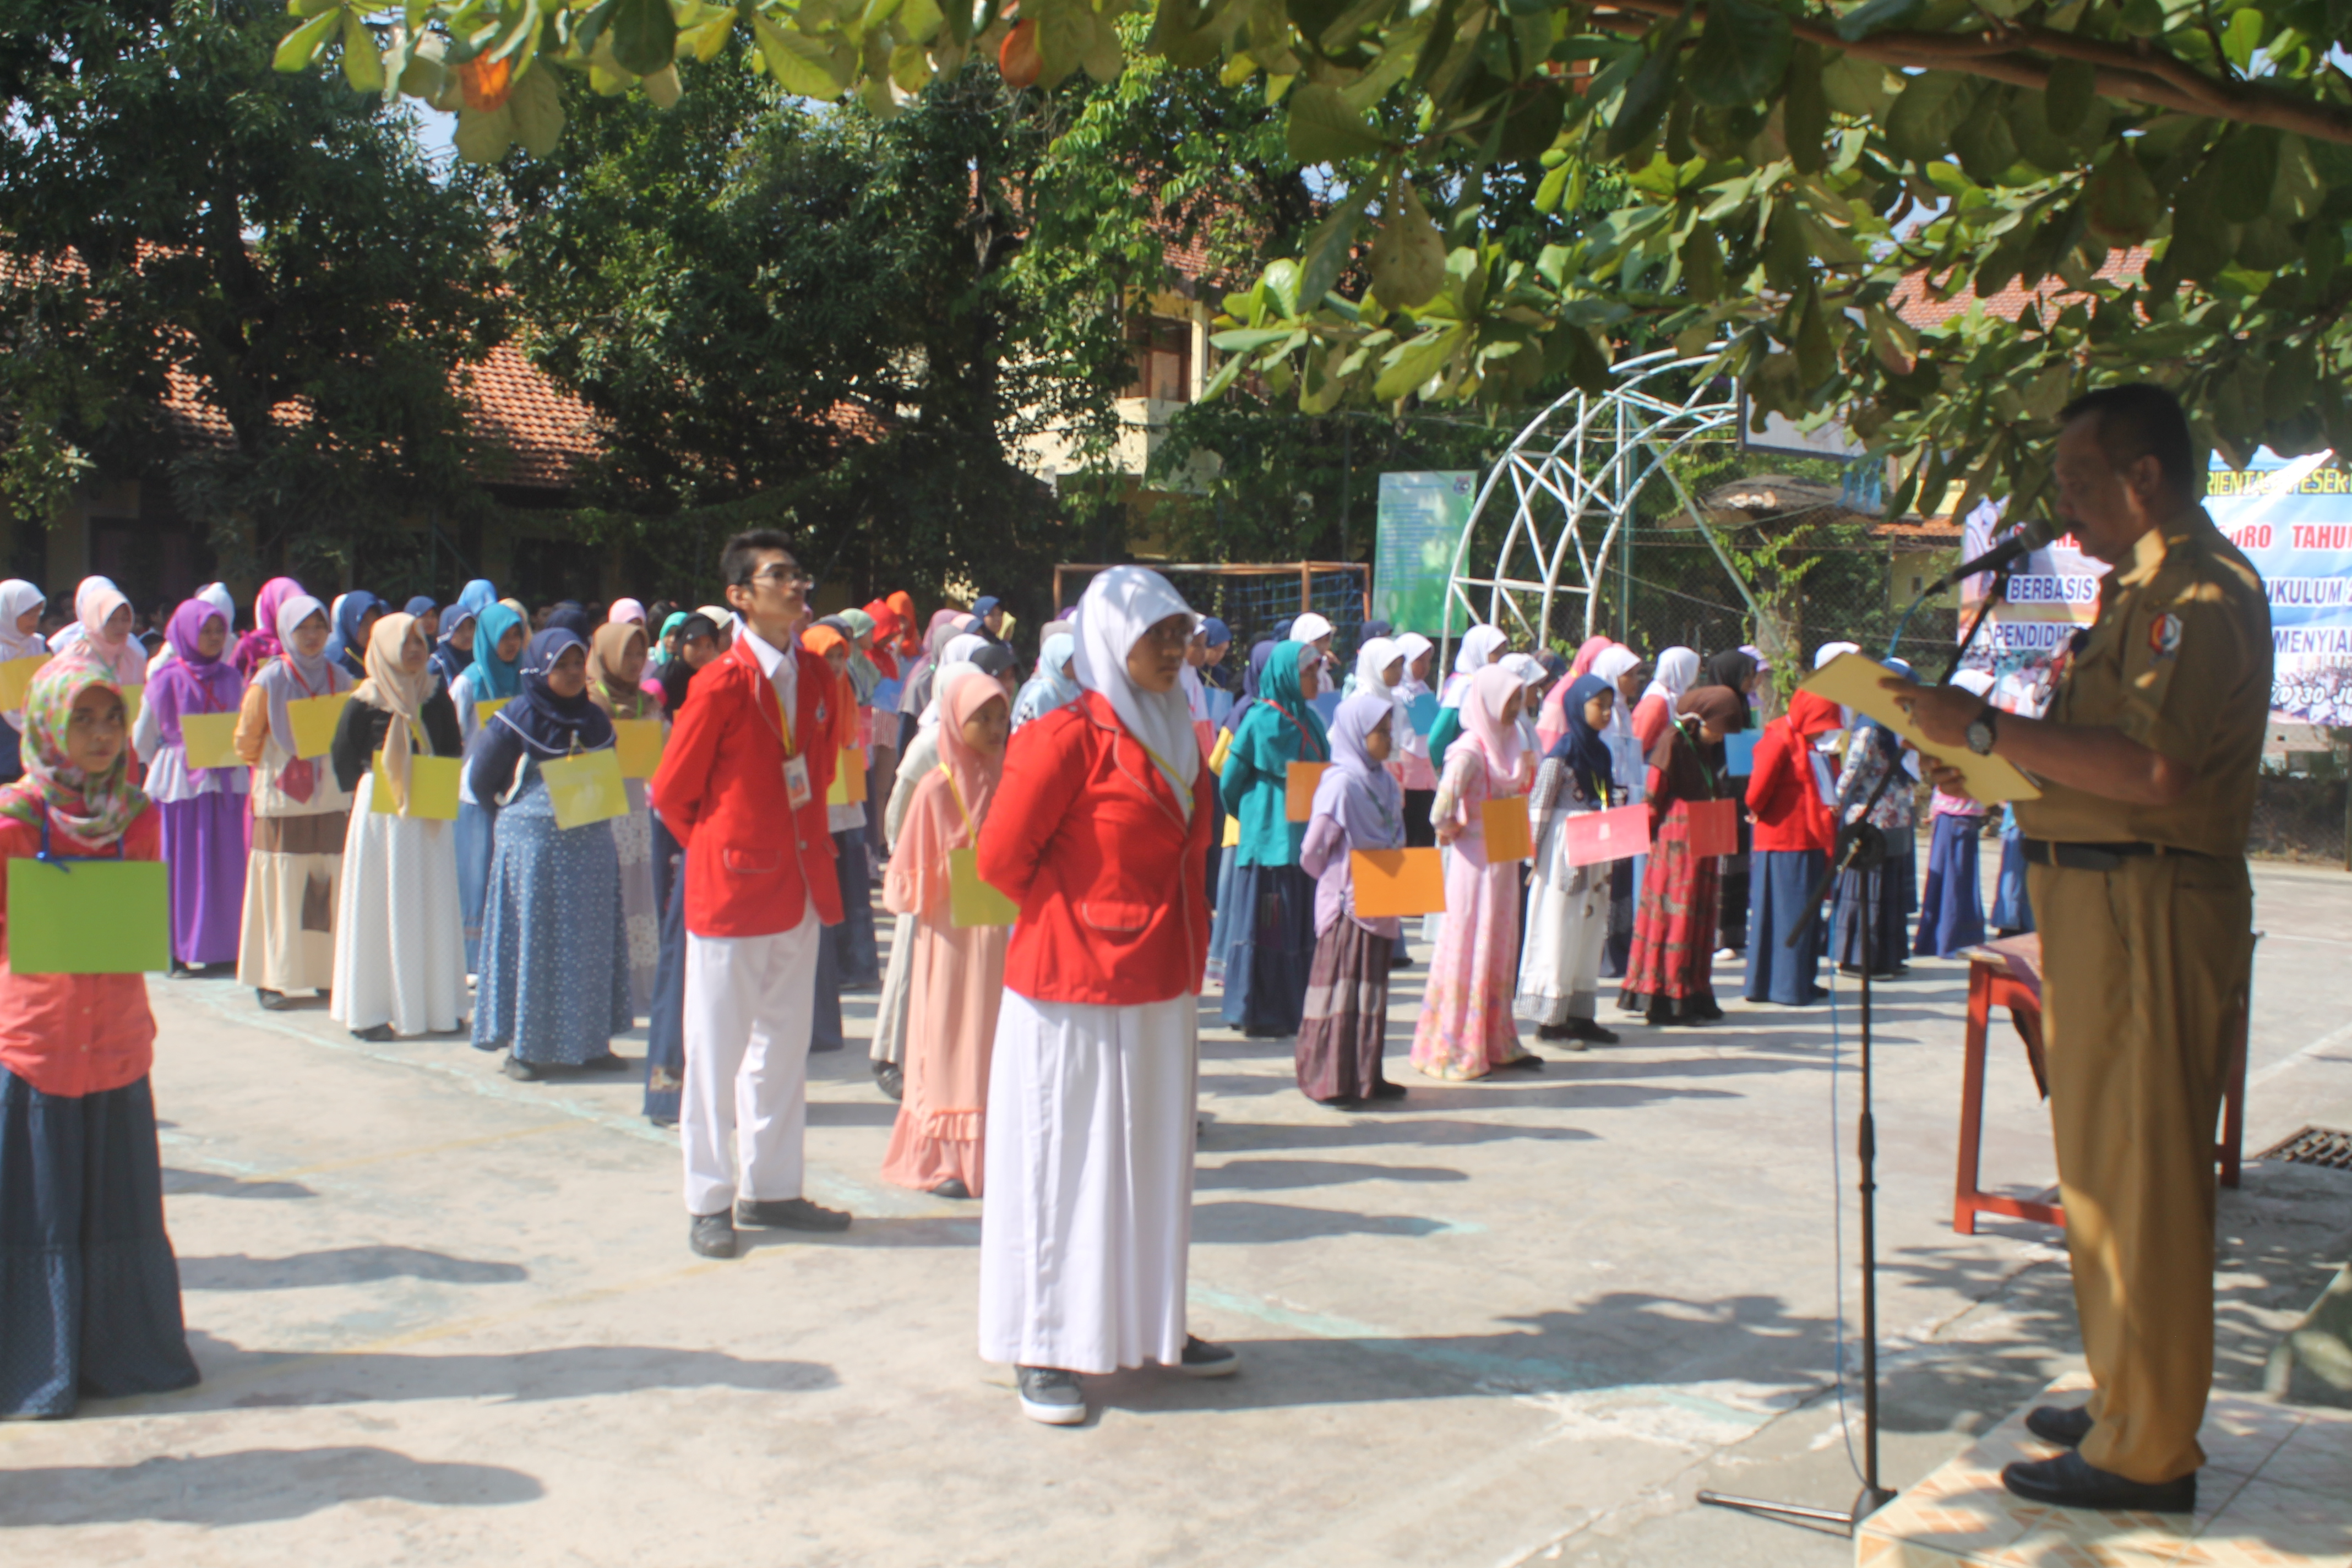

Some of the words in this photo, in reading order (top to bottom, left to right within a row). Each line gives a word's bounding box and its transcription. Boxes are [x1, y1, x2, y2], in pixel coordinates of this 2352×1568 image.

[2291, 525, 2352, 549] TAHU
[2010, 578, 2093, 600] BERBASIS
[2273, 629, 2352, 653] MENYIA
